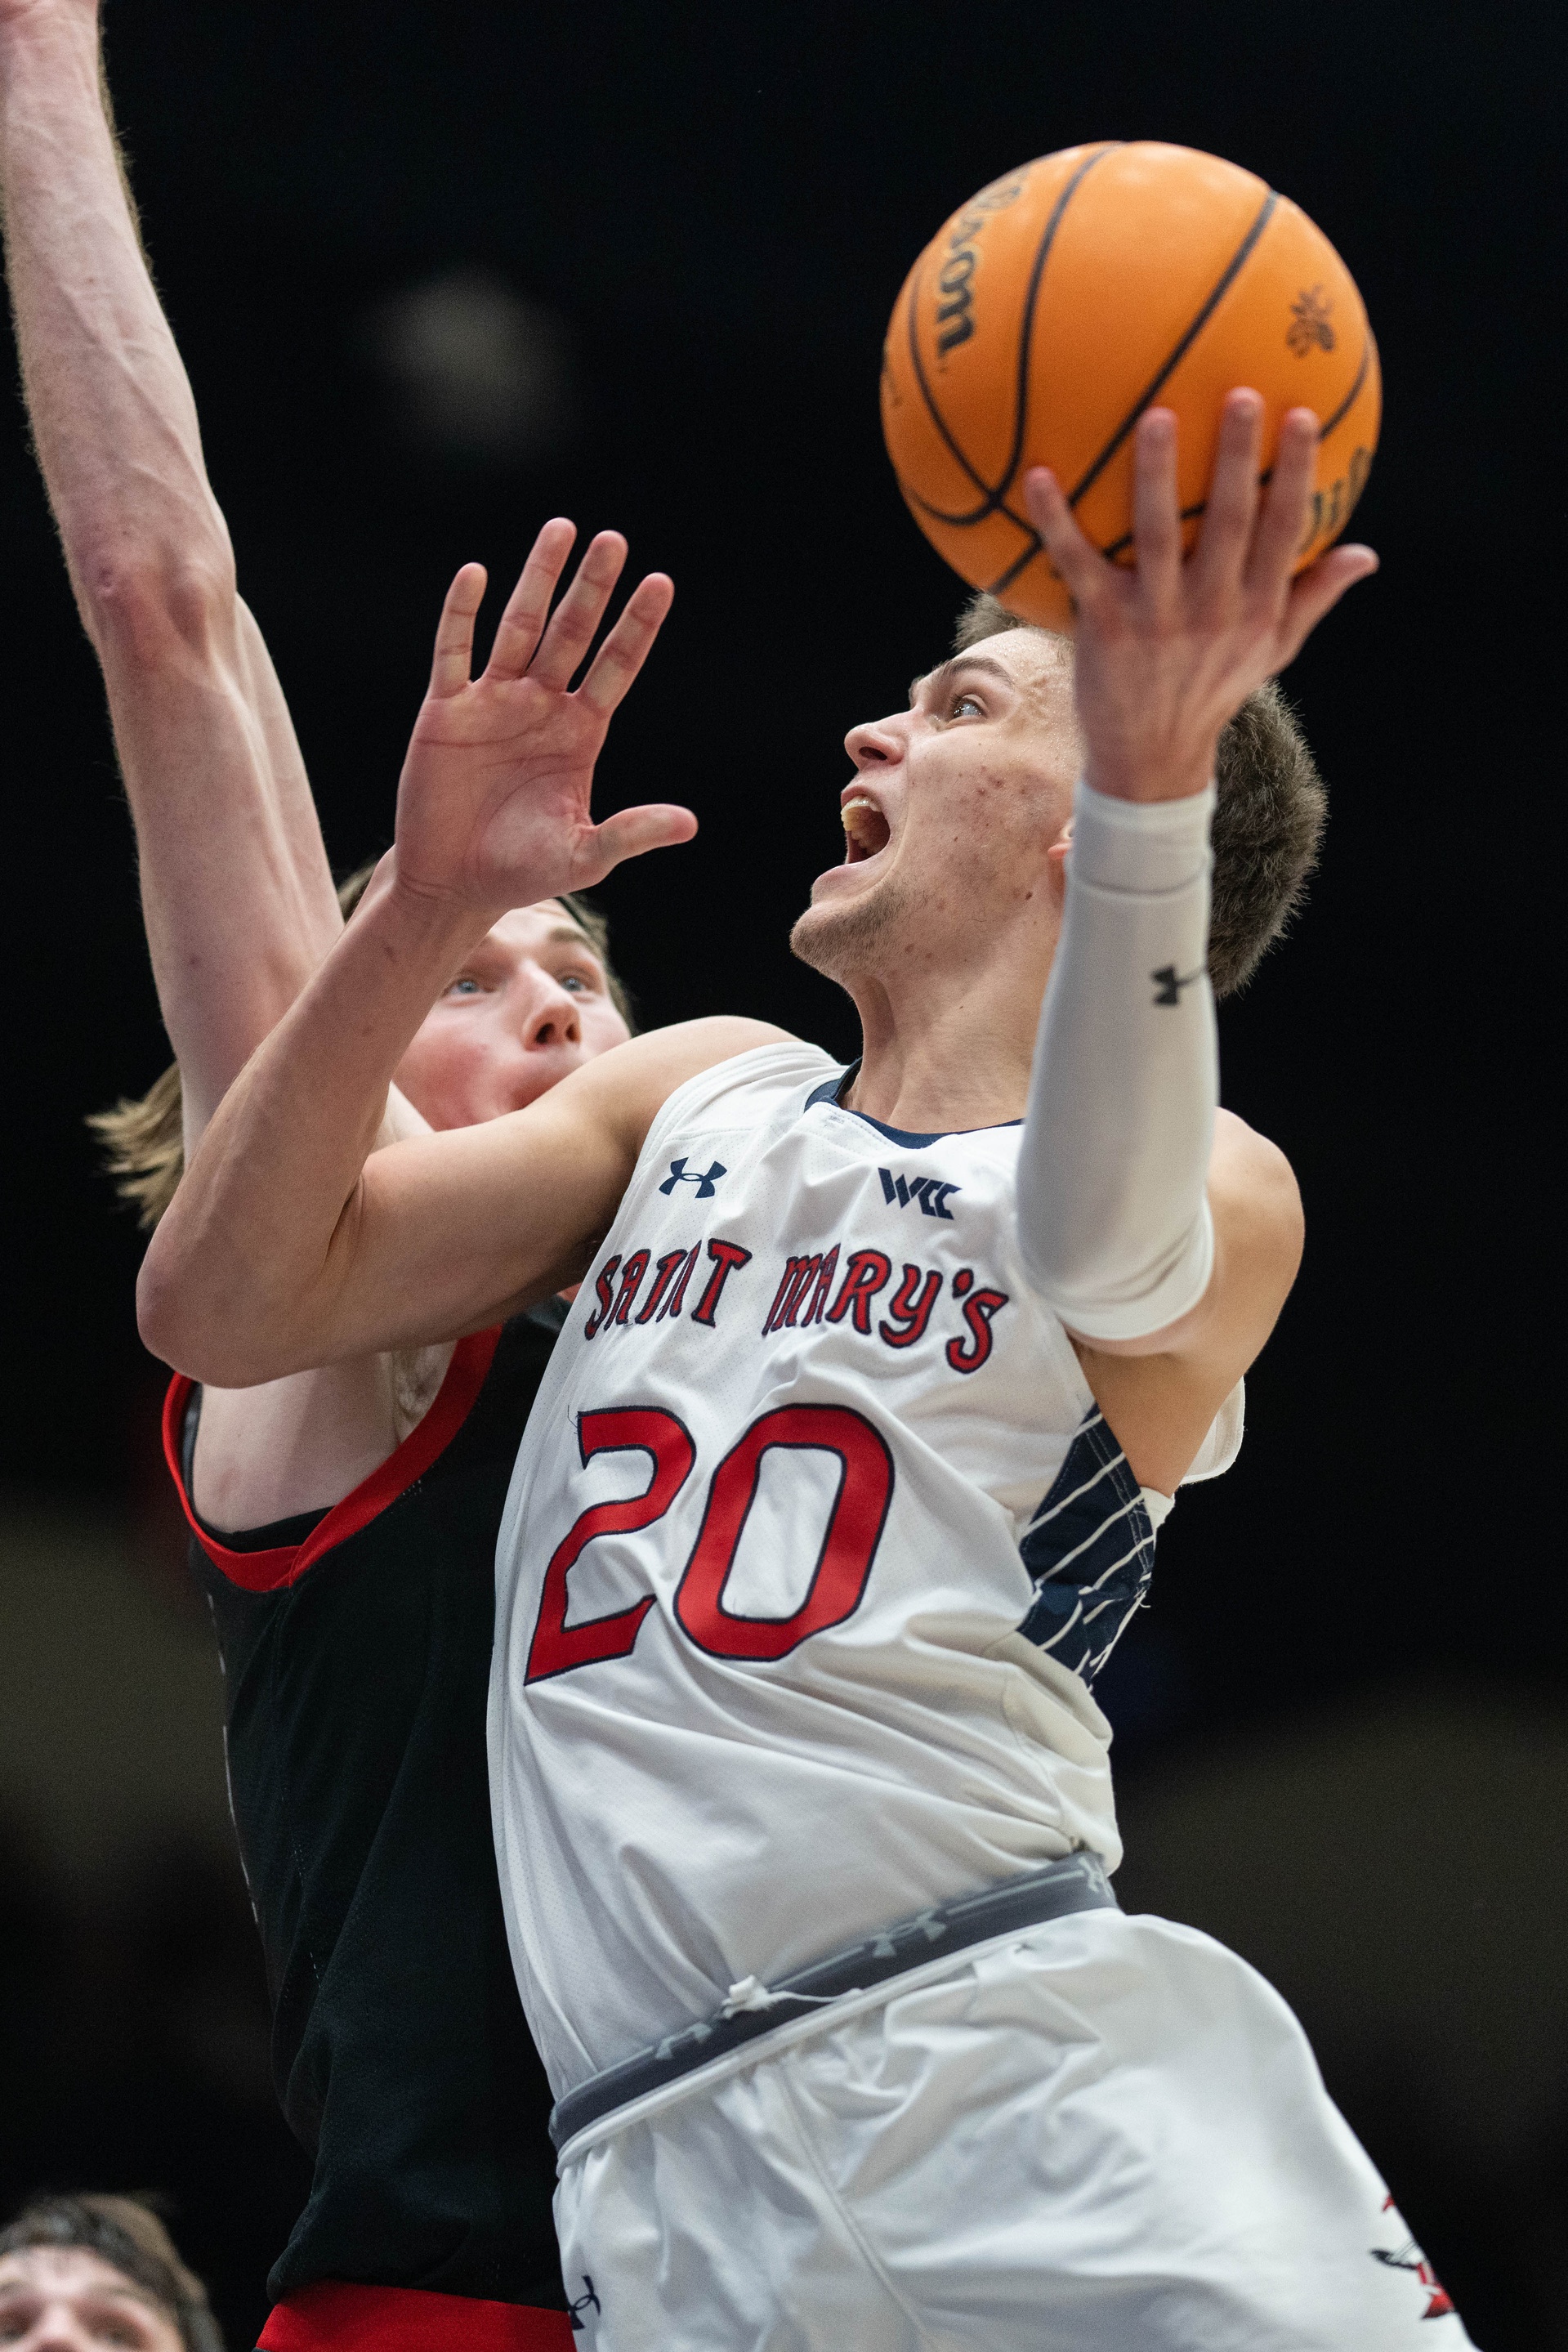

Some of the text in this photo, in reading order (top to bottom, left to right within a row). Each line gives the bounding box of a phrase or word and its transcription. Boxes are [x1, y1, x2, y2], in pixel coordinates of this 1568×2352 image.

[878, 1167, 962, 1221] WCC
[584, 1237, 1010, 1375] SAINT MARY'S
[524, 1402, 896, 1687] 20
